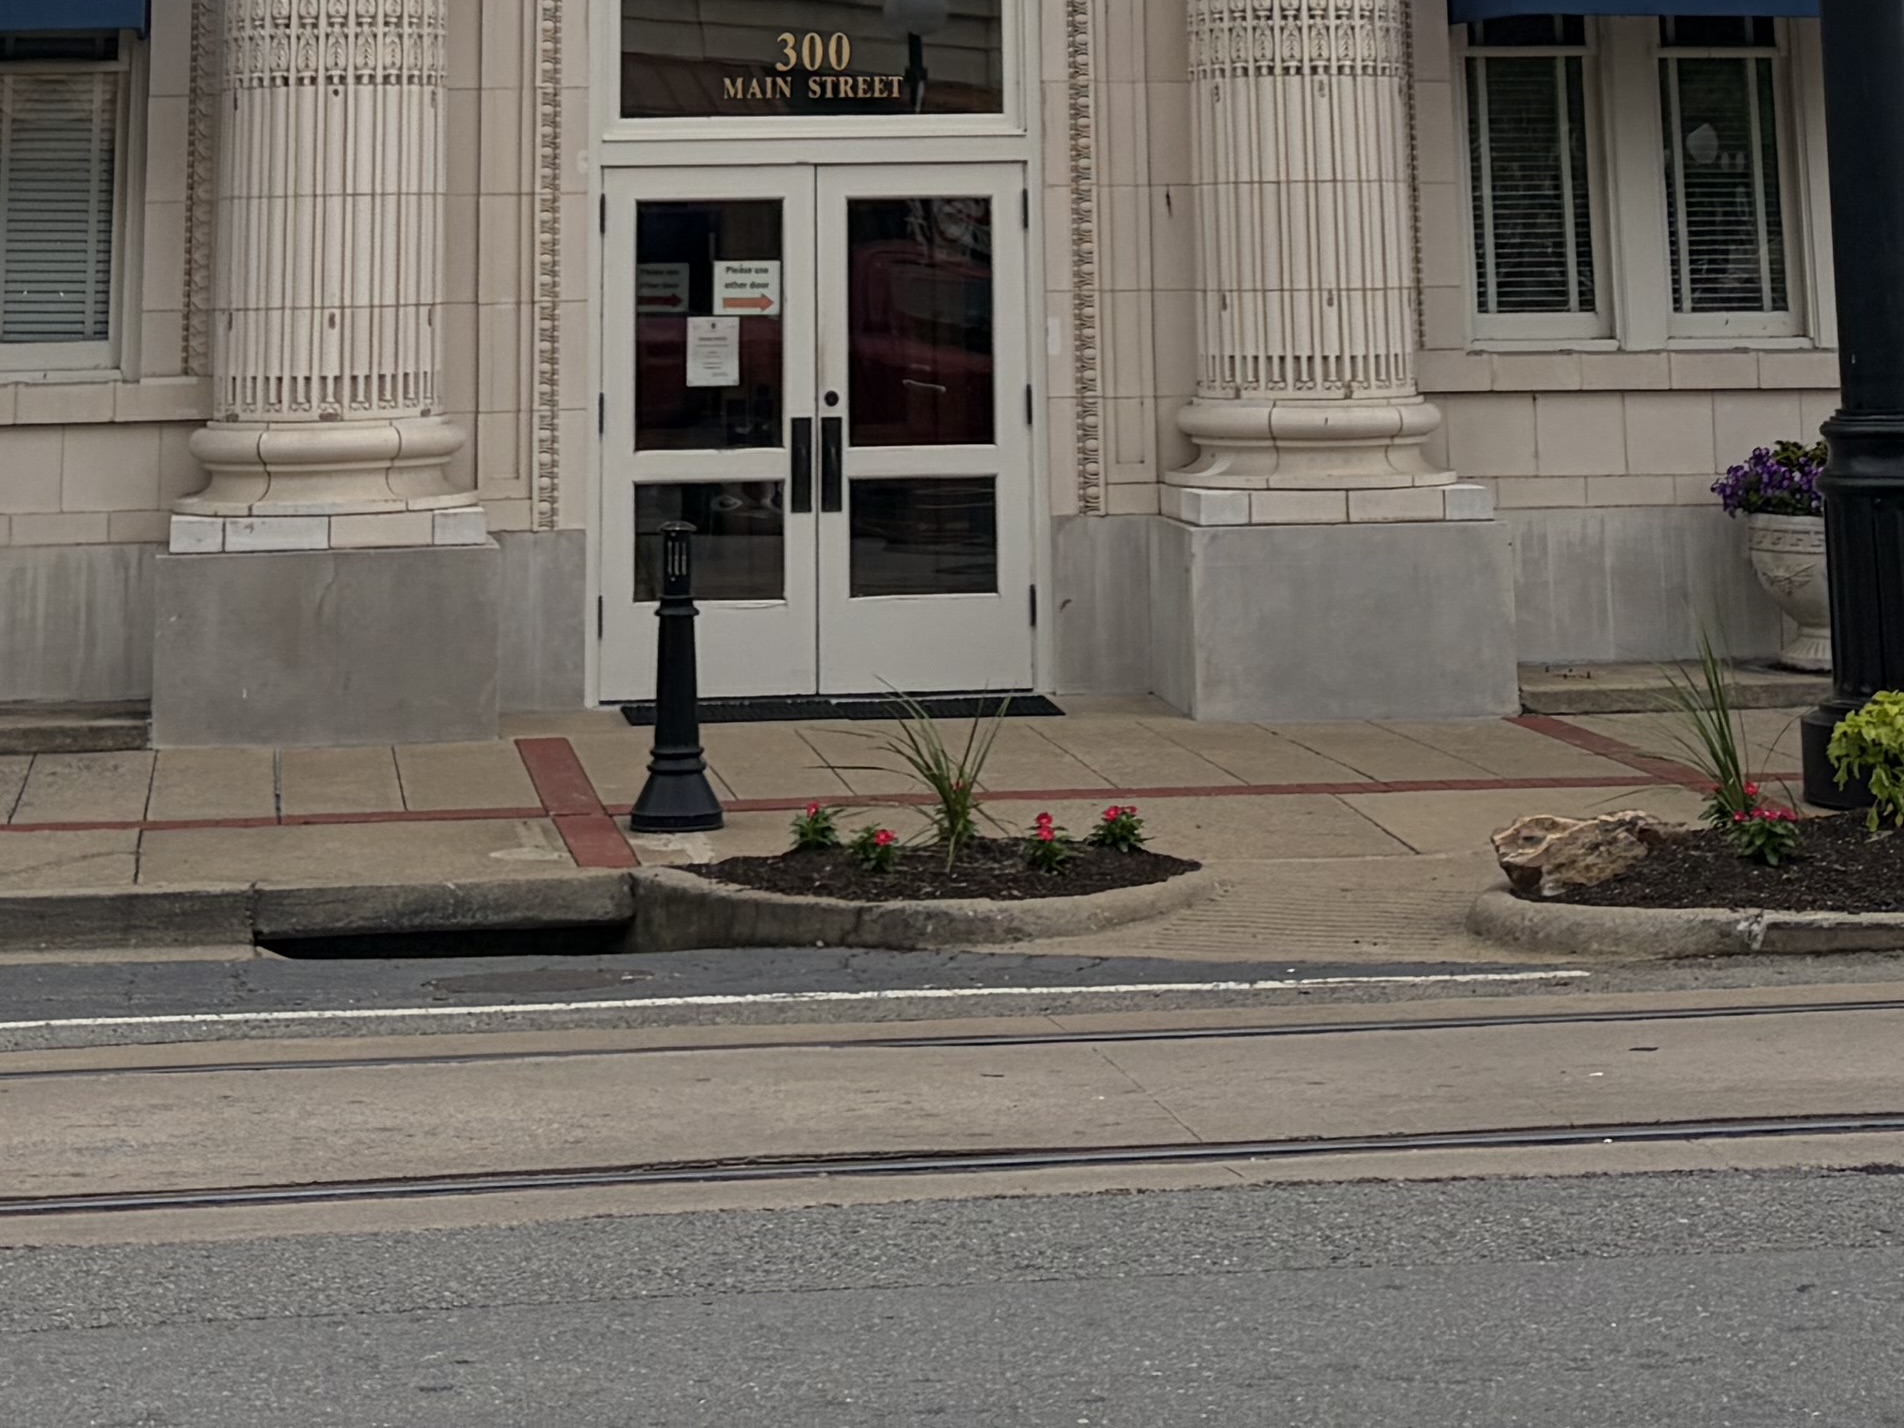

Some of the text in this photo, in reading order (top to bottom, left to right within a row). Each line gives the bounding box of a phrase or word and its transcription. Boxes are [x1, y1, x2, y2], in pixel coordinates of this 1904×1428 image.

[774, 31, 852, 72] 300
[723, 76, 904, 99] MAIN STREET
[725, 266, 752, 274] Please
[724, 281, 769, 289] other door
